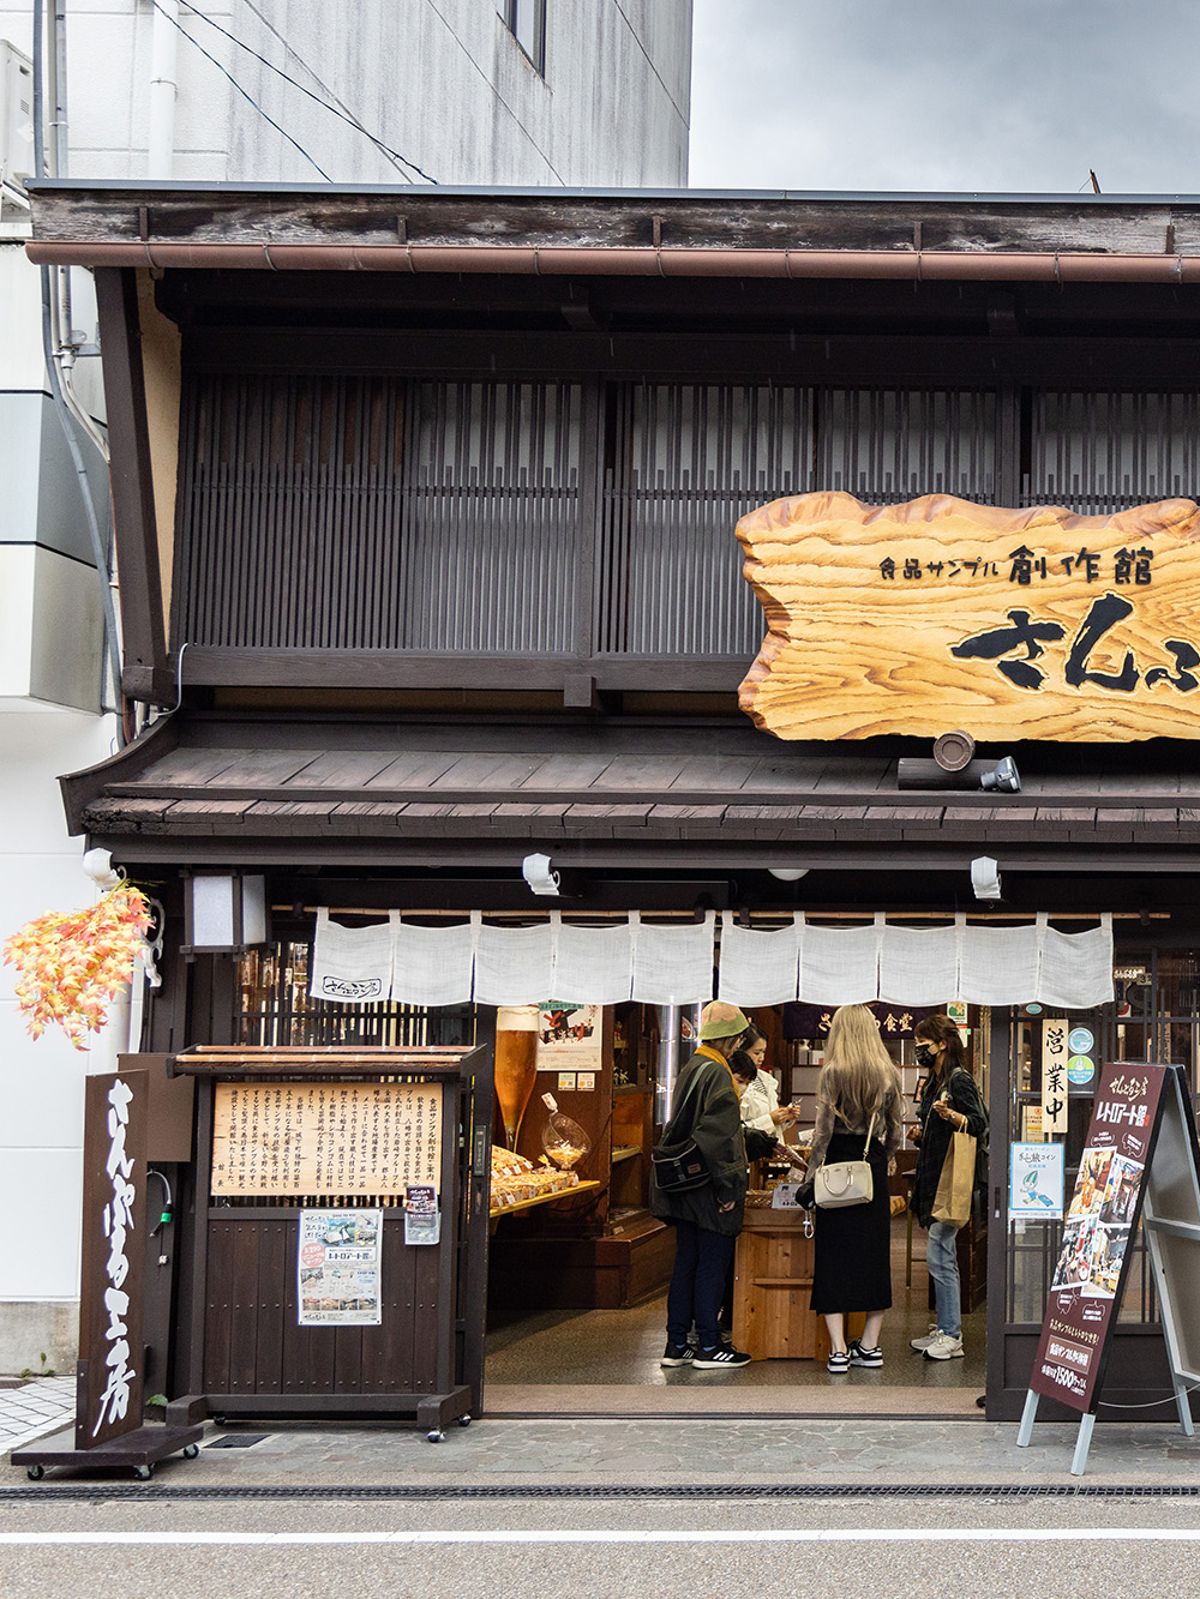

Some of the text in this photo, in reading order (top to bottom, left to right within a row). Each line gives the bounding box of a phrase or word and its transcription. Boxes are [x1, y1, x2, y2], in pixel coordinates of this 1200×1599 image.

[879, 544, 1154, 586] 食品サンプル創作館
[1045, 1027, 1065, 1123] 営業中
[1109, 1075, 1149, 1102] さんぷる工房
[92, 1078, 136, 1438] さんぷる工房
